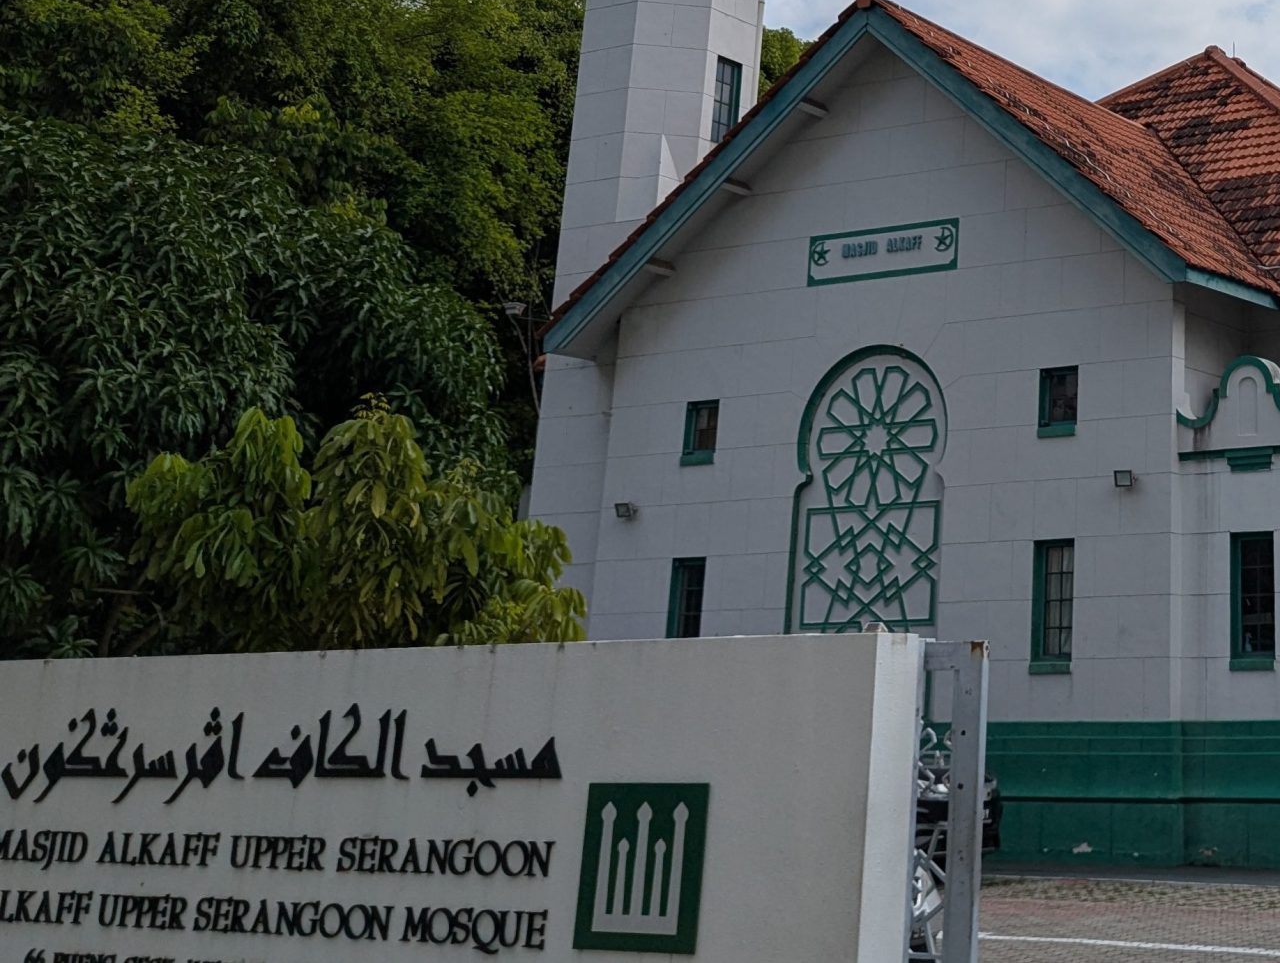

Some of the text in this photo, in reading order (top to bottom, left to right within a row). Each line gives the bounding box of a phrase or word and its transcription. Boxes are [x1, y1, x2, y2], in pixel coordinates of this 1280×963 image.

[842, 235, 923, 259] MASJID ALKAFF
[420, 736, 562, 798] مسجد
[96, 831, 221, 869] ALKAFF
[230, 834, 326, 873] UPPER
[336, 835, 556, 880] SERANGOON
[0, 889, 548, 958] LKAFF UPPER SERANGOON MOSQUE
